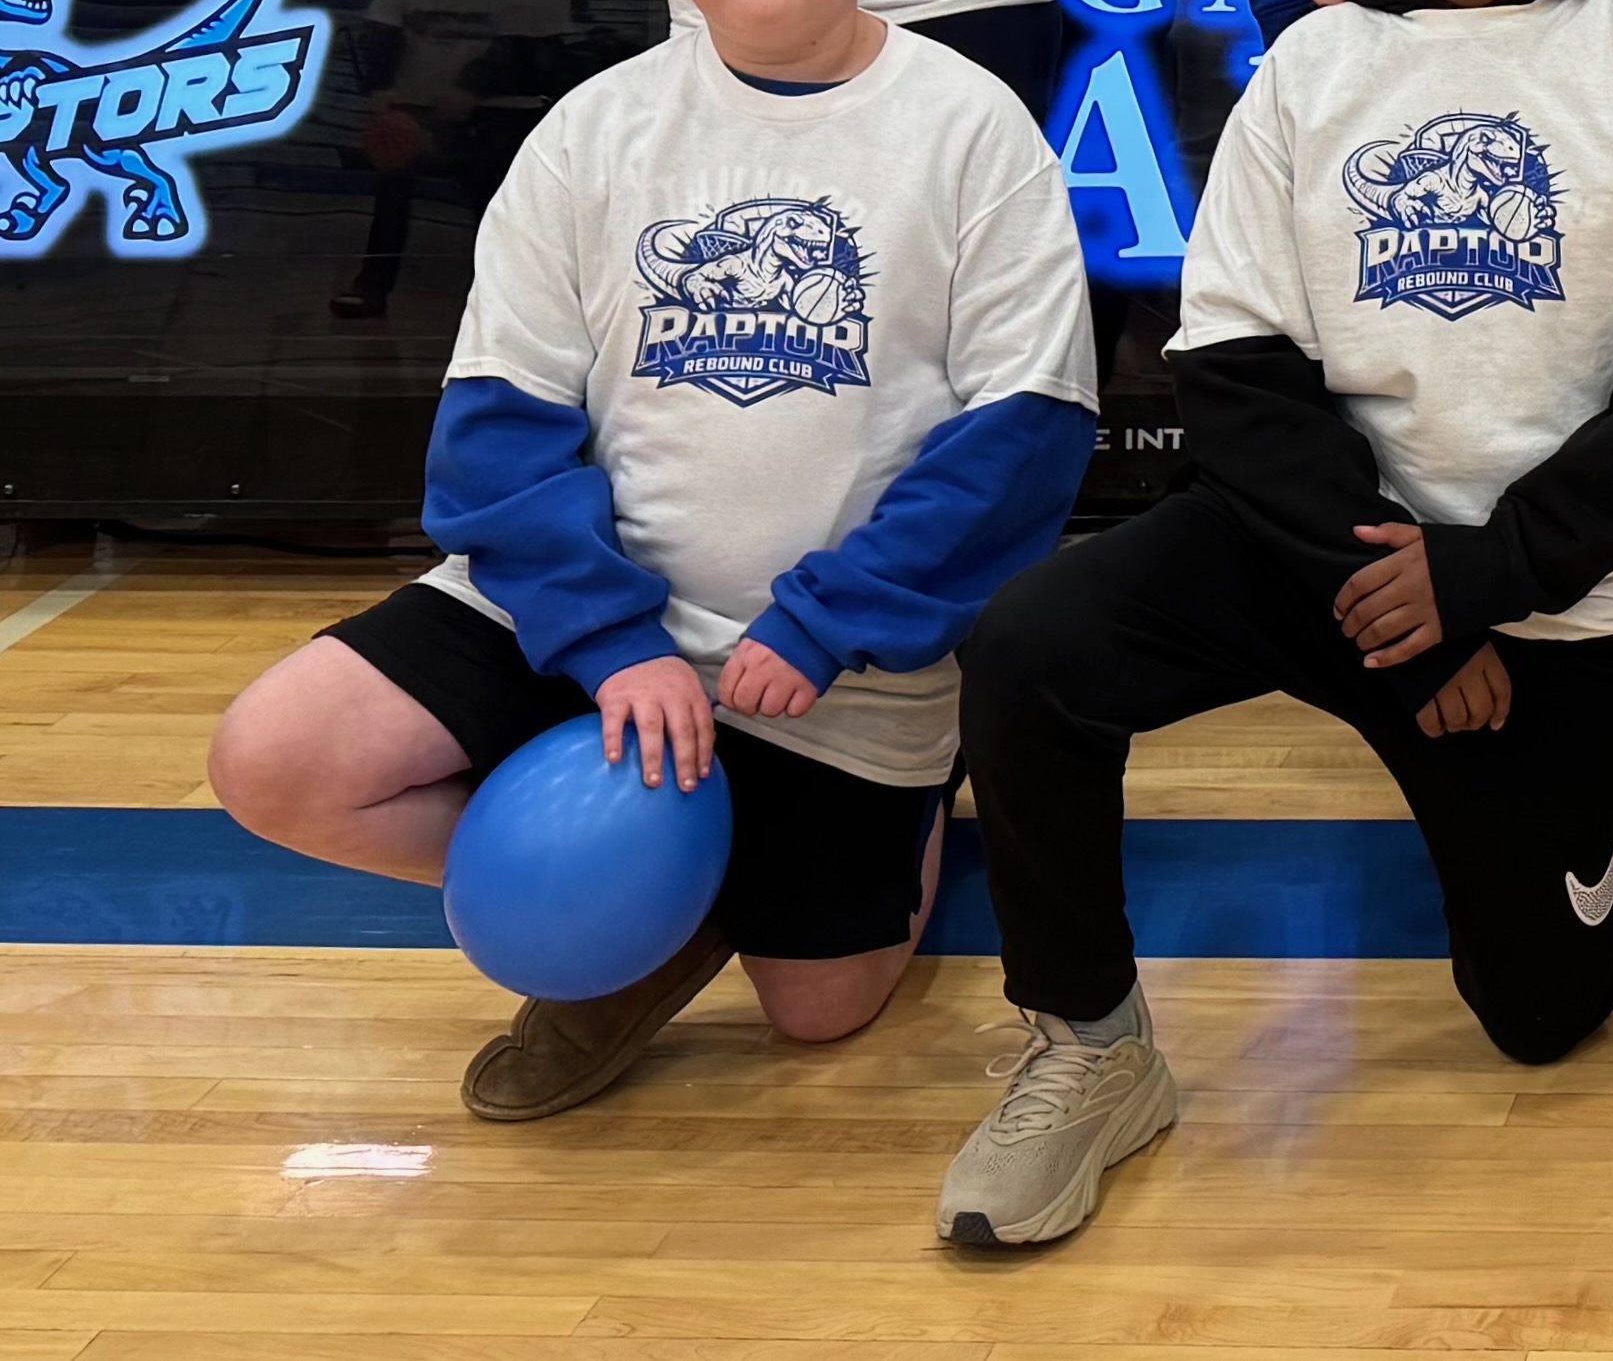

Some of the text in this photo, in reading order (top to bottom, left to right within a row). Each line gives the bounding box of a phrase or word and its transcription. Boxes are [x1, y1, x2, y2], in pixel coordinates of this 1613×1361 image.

[1360, 228, 1562, 296] RAPTOR
[1397, 272, 1514, 292] REBOUND CLUB
[638, 306, 867, 379] RAPTOR
[683, 357, 813, 379] REBOUND CLUB
